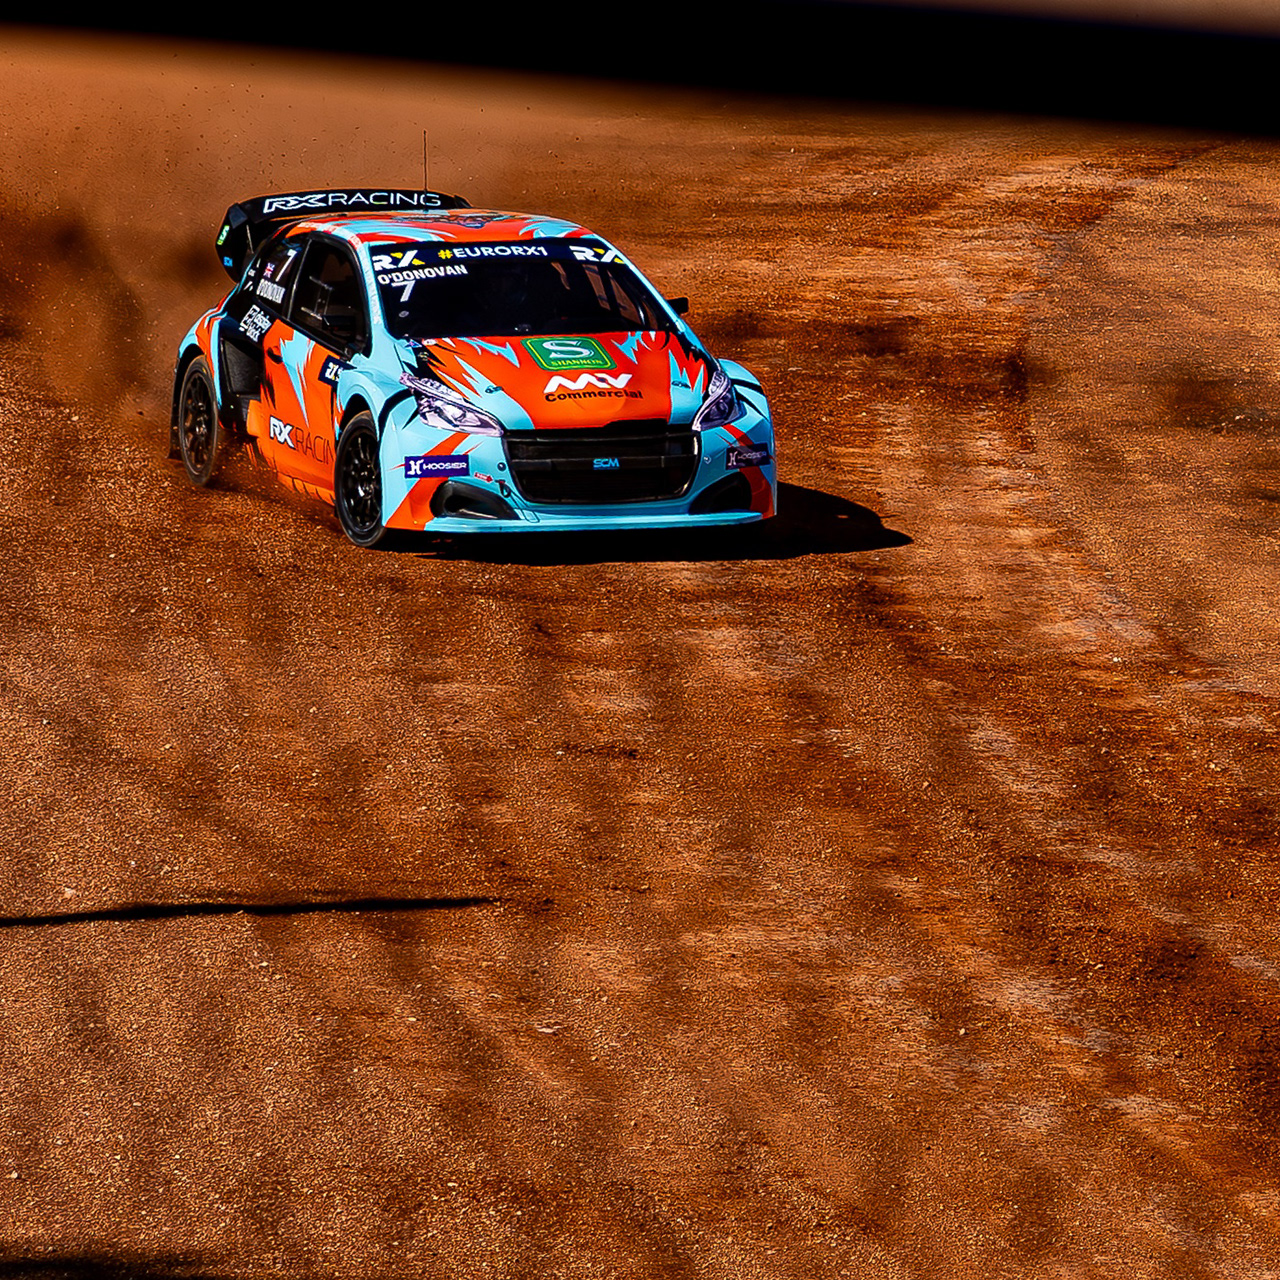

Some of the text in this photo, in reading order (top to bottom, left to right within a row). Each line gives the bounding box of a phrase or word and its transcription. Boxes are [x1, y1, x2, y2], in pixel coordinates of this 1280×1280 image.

[372, 250, 425, 271] RX
[438, 245, 548, 260] #EURORX1
[569, 246, 625, 264] RX
[275, 248, 297, 282] 7
[377, 265, 468, 285] O'DONOVAN
[391, 281, 416, 303] 7
[551, 359, 604, 367] SHANNON
[545, 389, 644, 402] Commercial
[422, 461, 468, 471] HOOSIER
[593, 458, 619, 468] SCM
